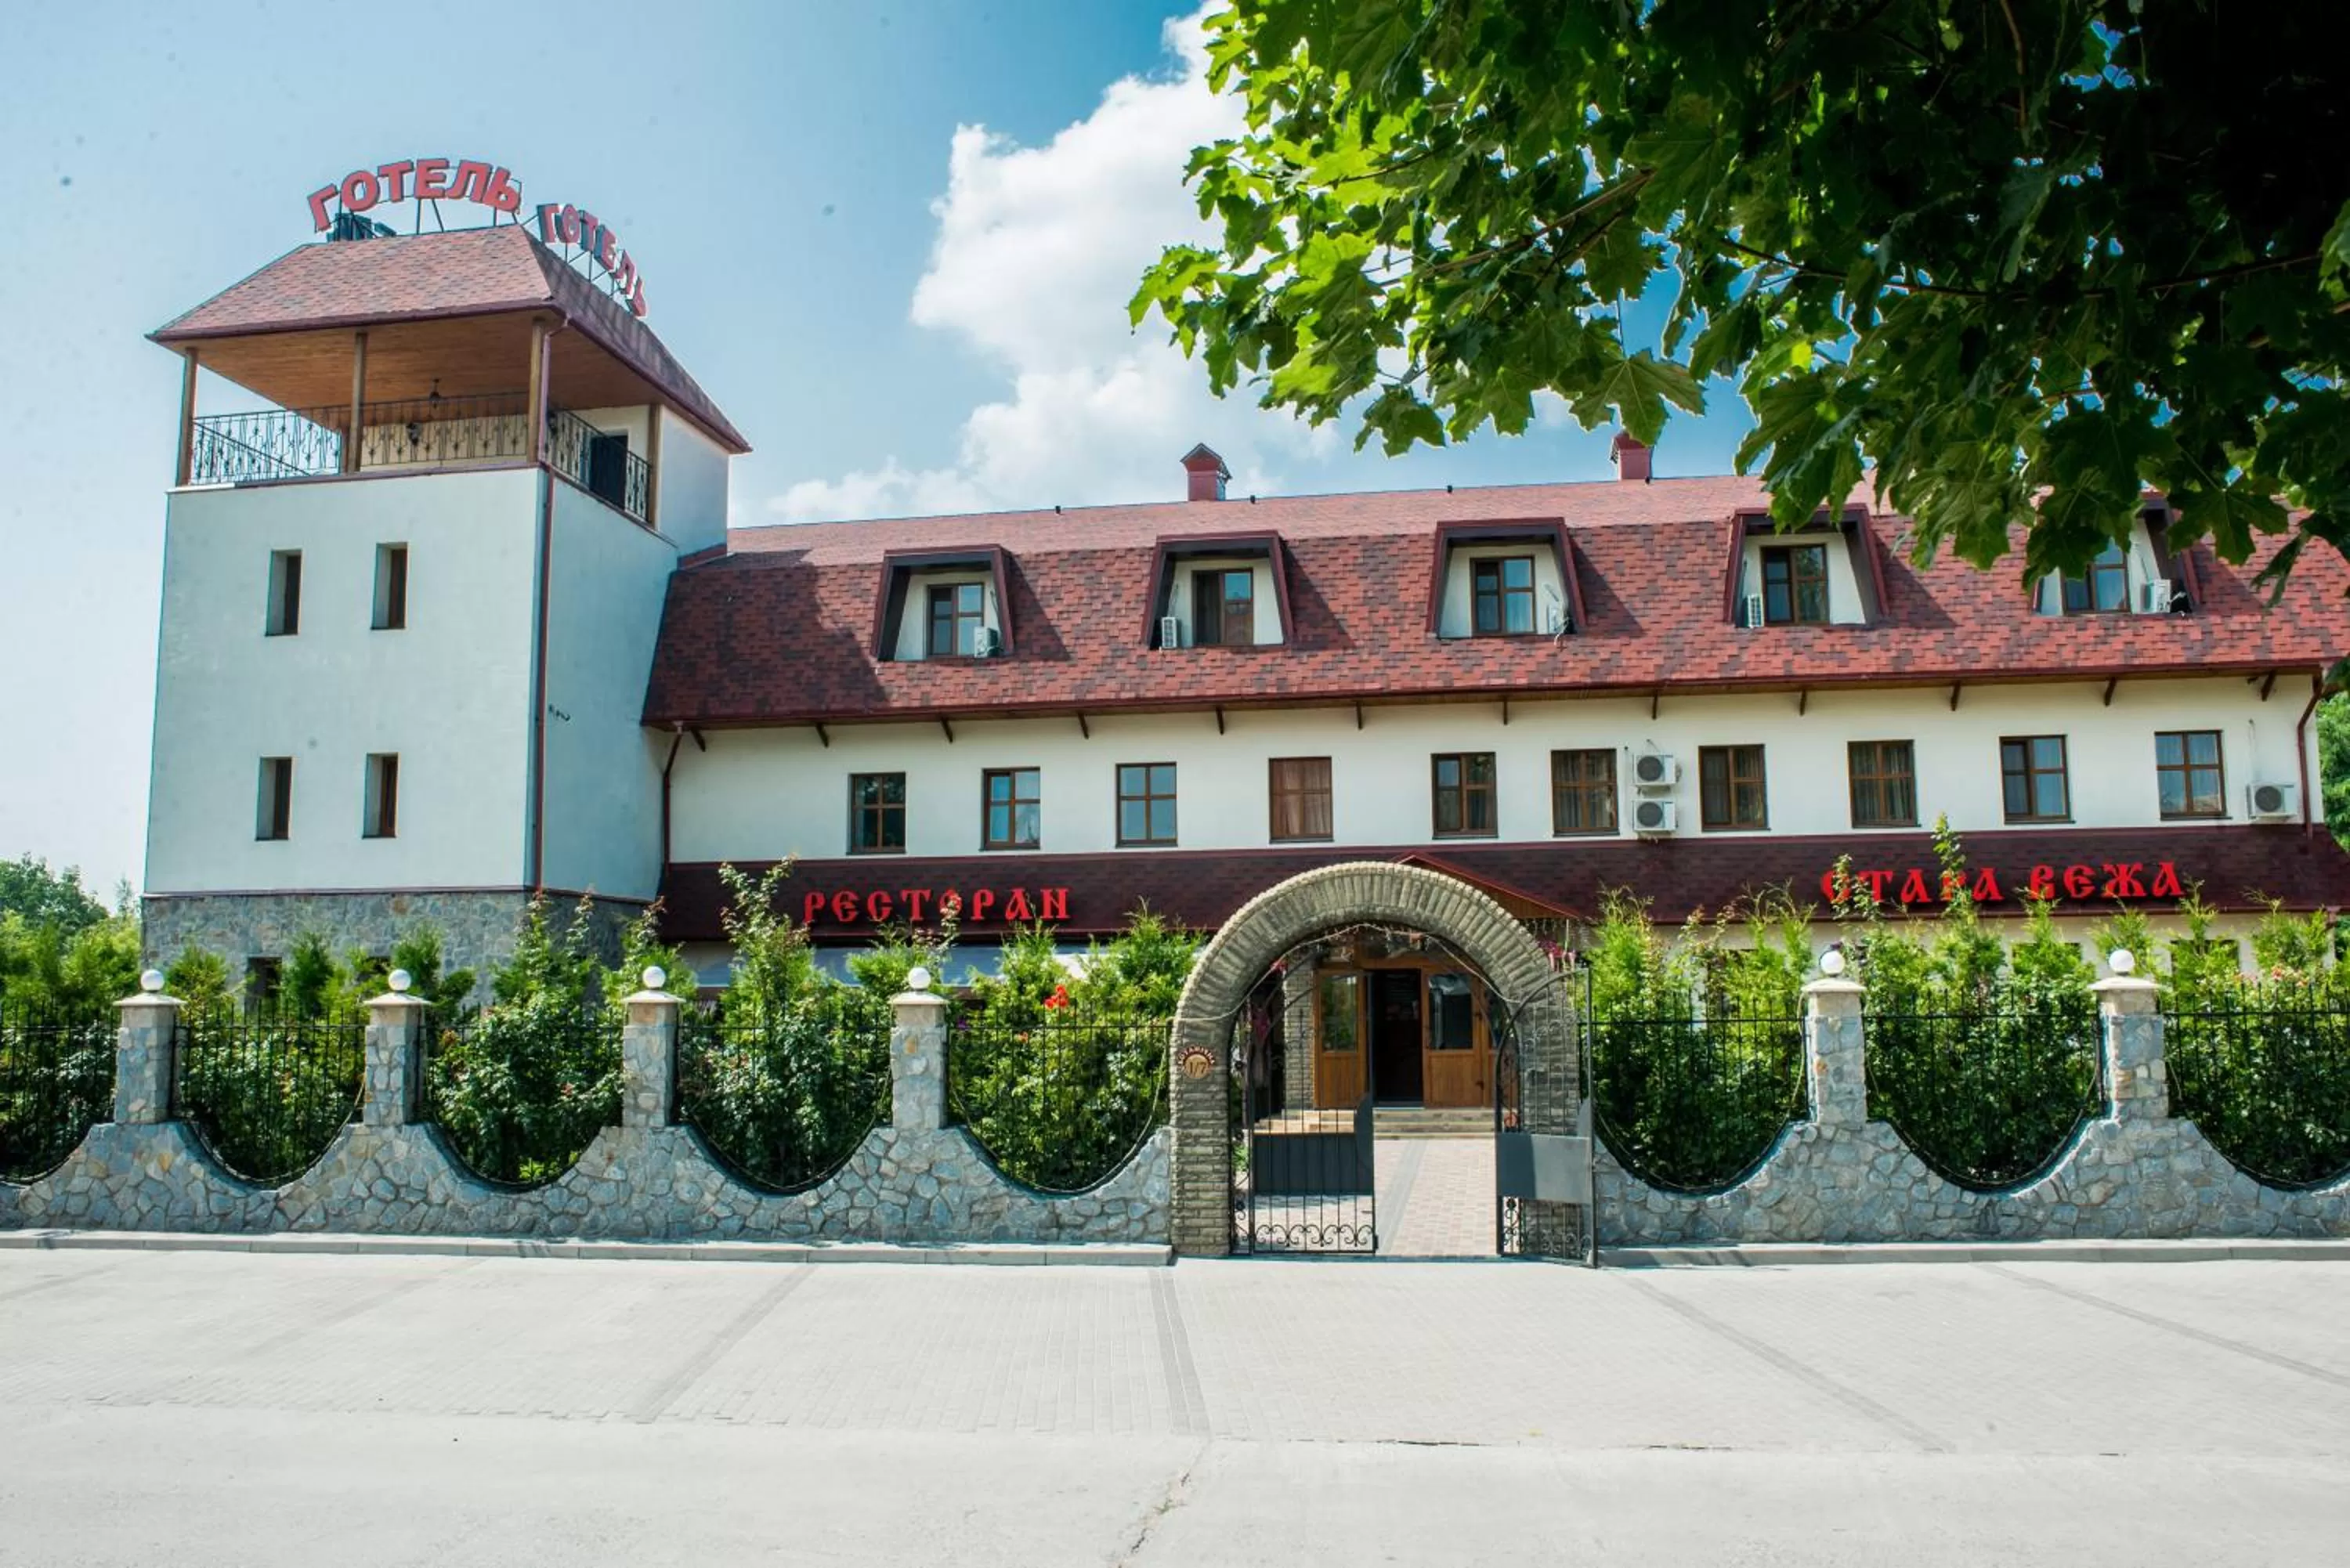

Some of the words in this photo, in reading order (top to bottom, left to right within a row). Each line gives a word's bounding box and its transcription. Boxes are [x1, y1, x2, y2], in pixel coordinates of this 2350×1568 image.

[307, 158, 522, 232] ГОТЕЛЬ
[537, 204, 646, 316] ГОТЕЛЬ
[802, 887, 1071, 924] РЕСТОРАН
[2030, 861, 2186, 900] ВЕЖА
